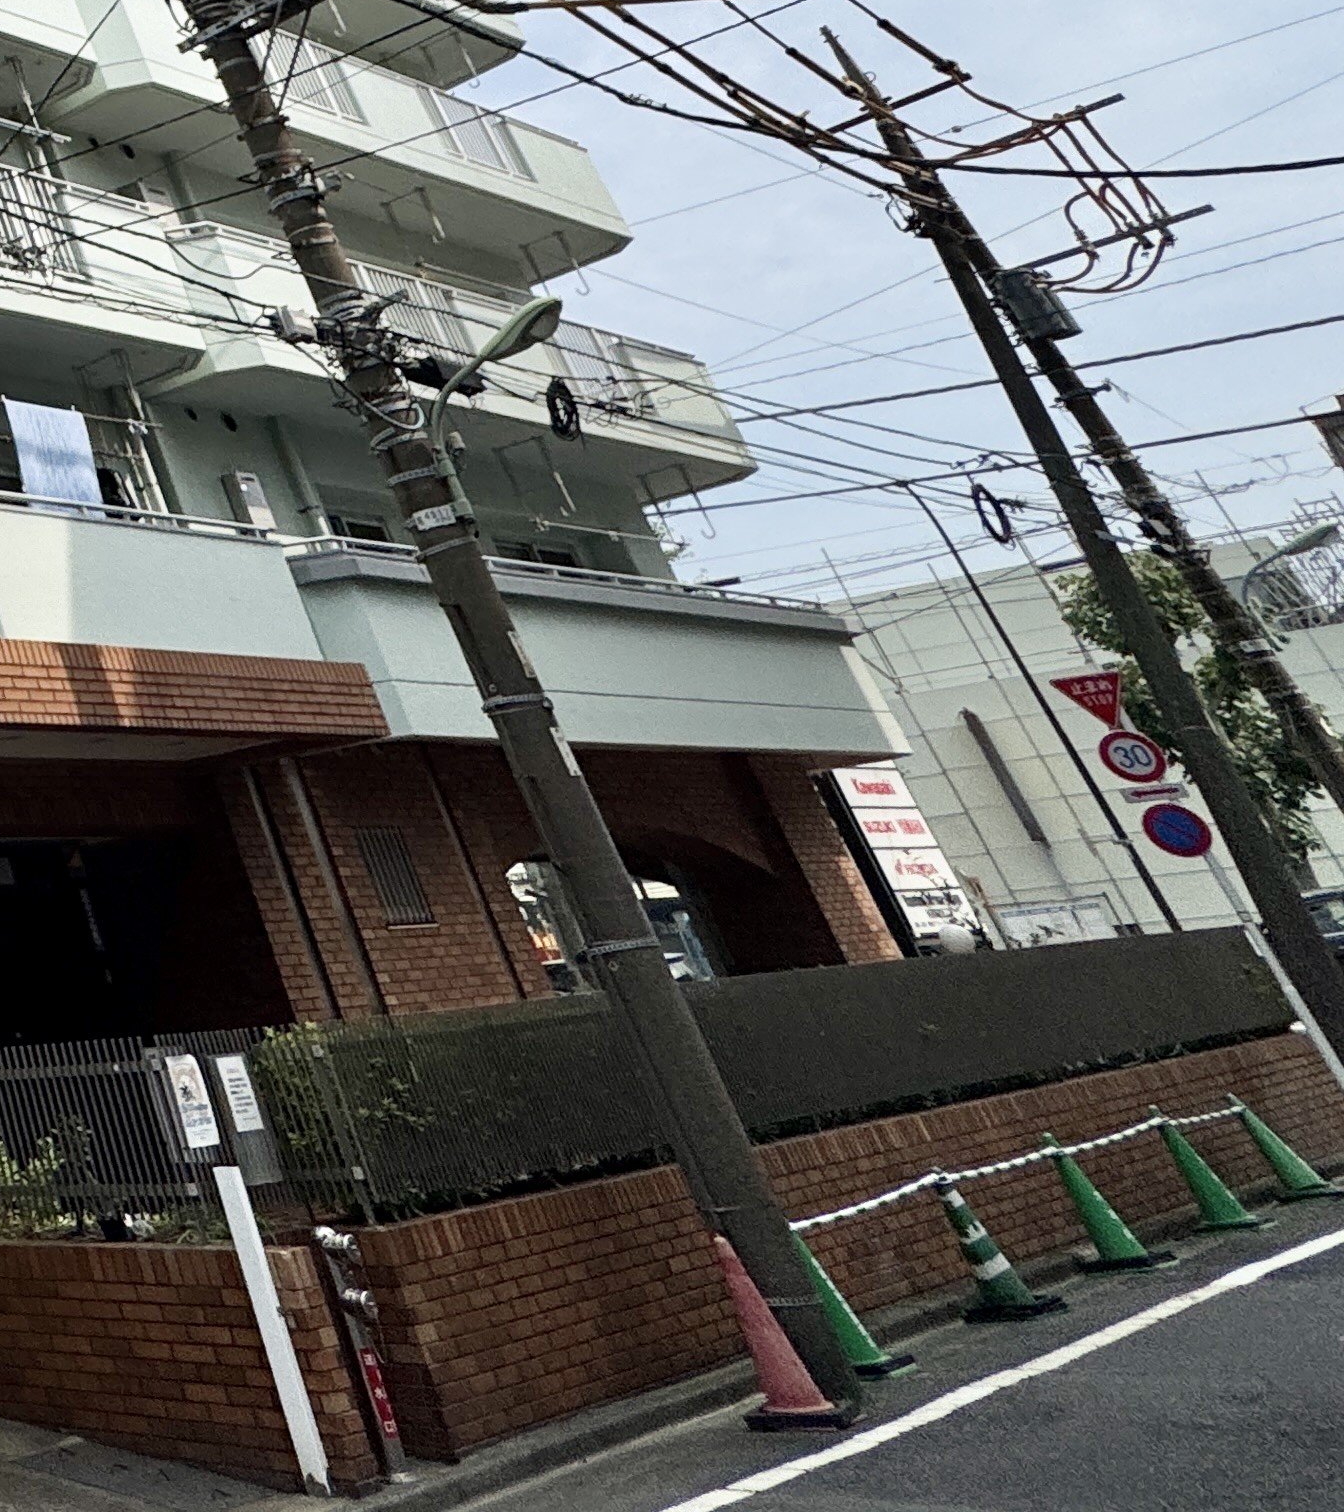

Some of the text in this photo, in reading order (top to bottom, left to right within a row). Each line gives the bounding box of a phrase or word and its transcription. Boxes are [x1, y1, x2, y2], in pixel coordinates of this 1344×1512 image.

[1071, 679, 1112, 696] 止まれ
[1083, 694, 1113, 707] STOP
[1113, 744, 1153, 769] 30
